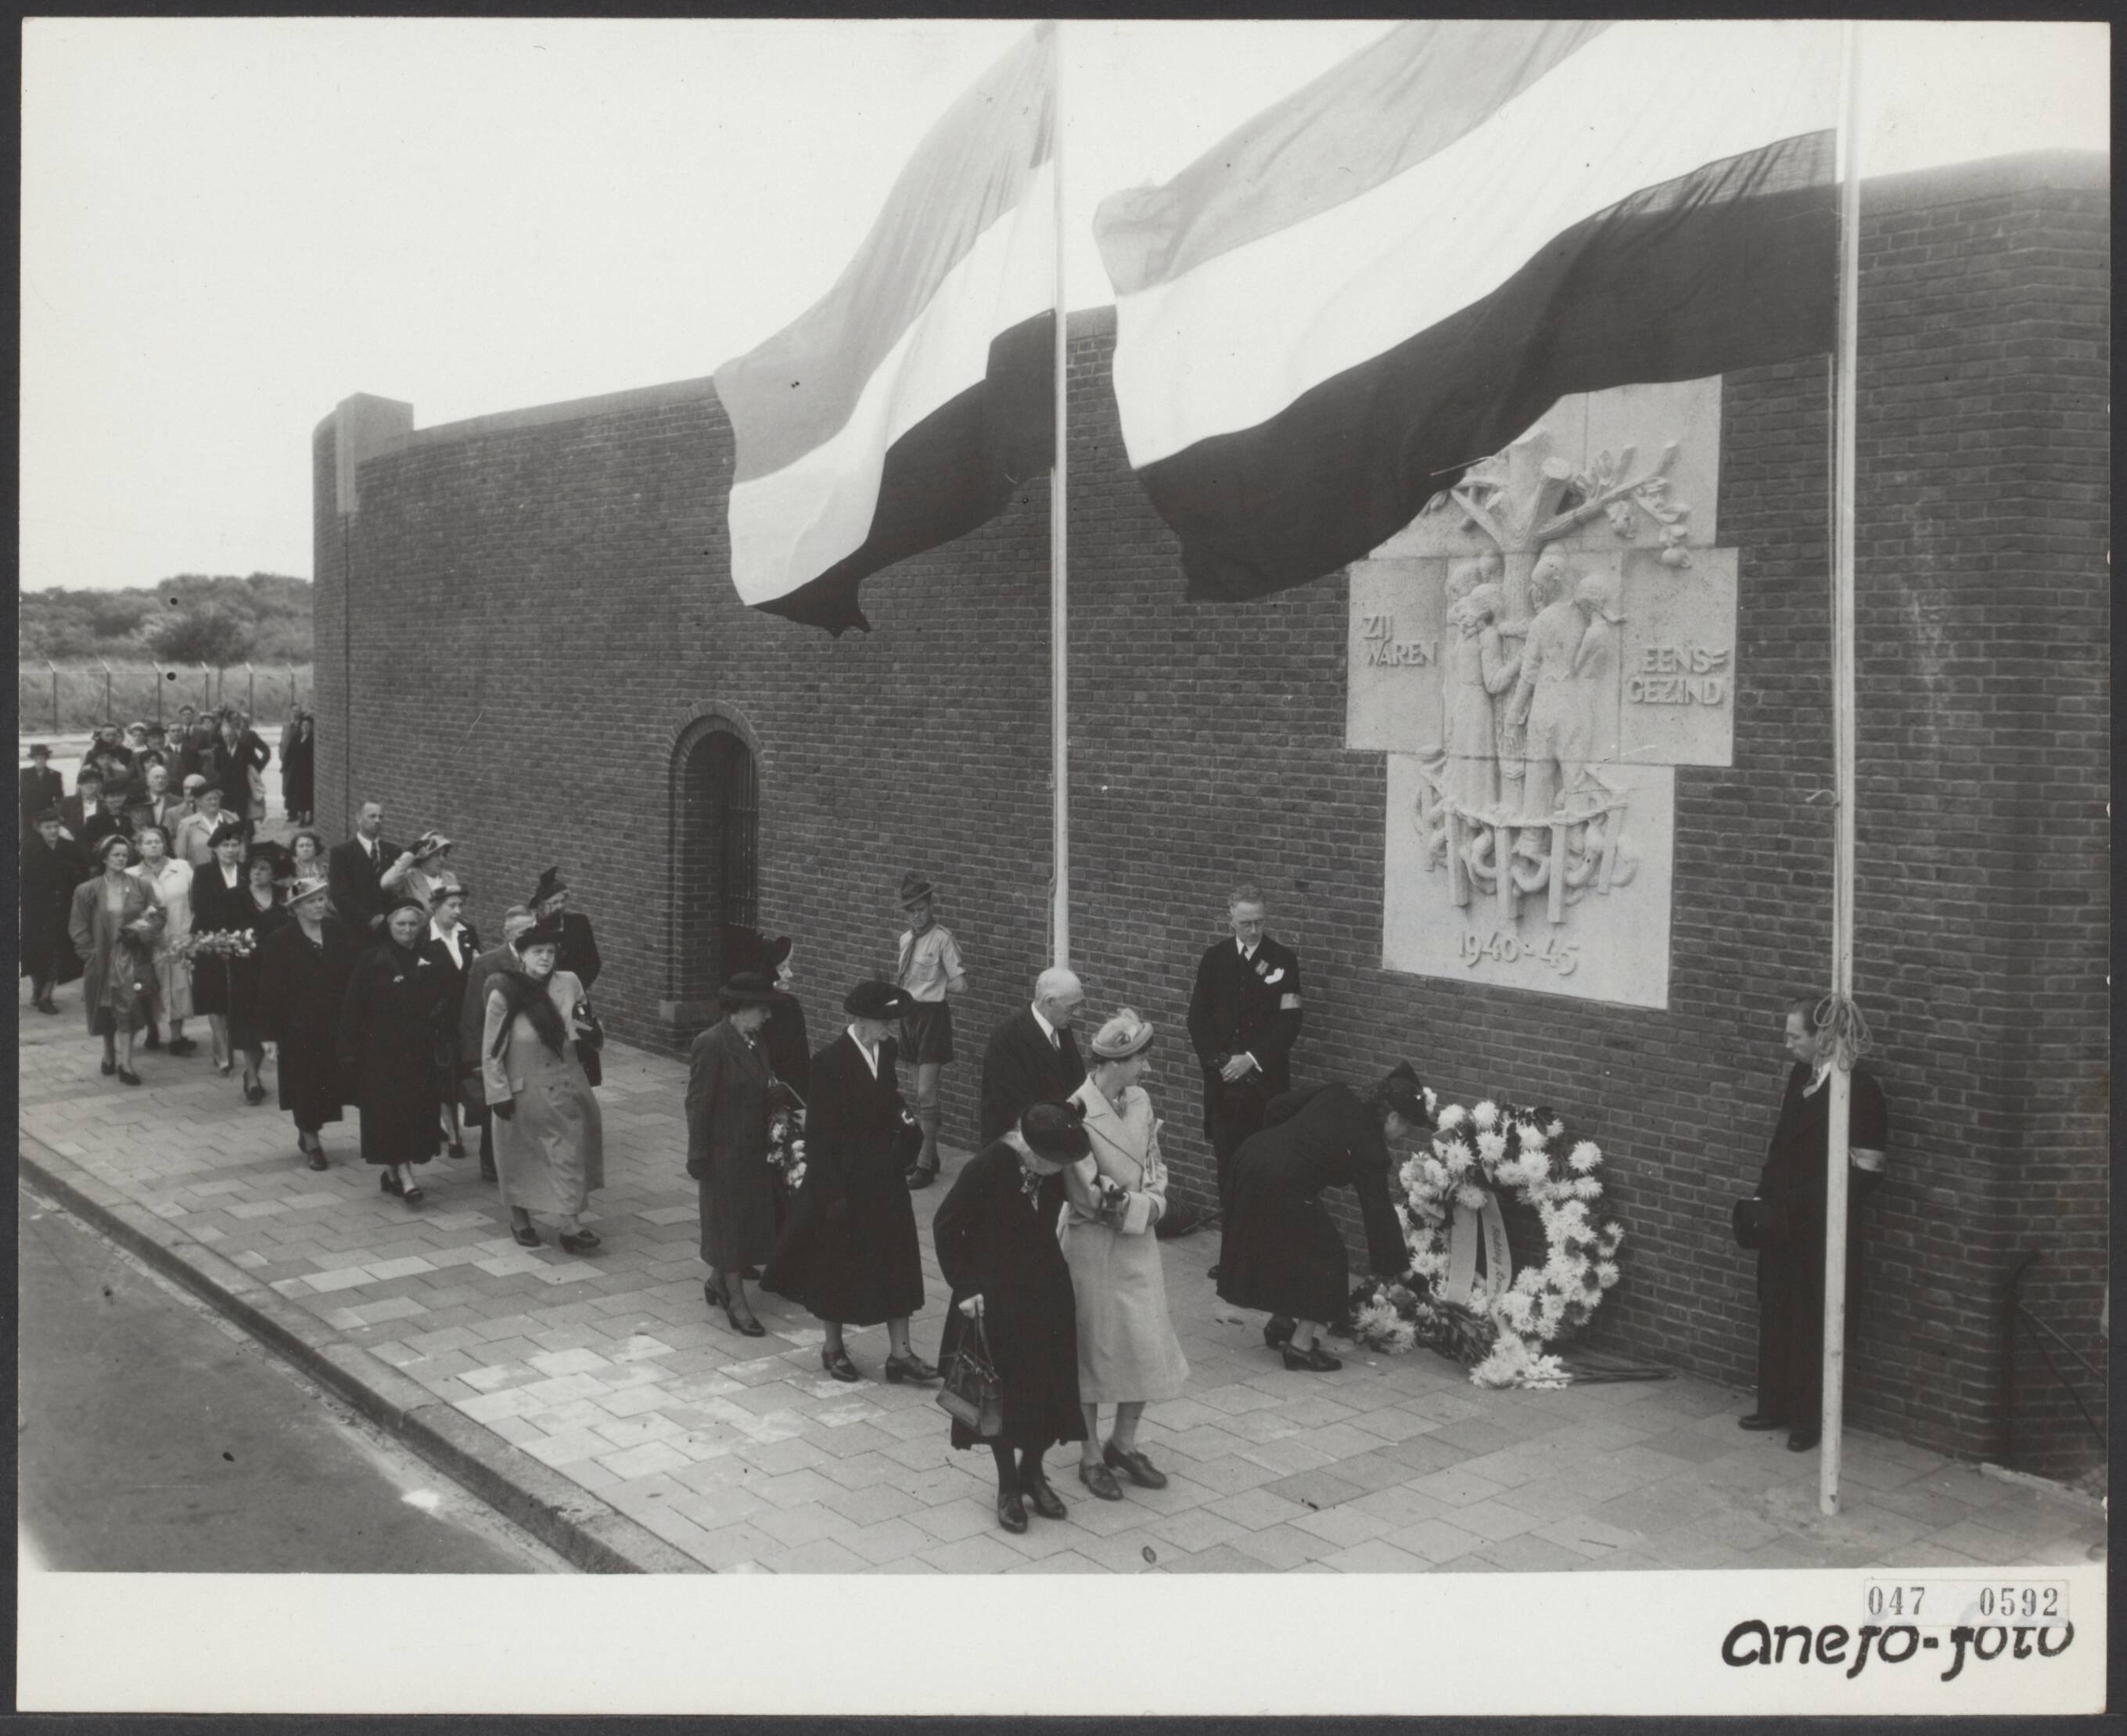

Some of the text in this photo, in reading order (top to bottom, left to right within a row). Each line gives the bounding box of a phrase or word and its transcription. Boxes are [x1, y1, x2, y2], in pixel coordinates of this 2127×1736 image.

[1362, 613, 1394, 642] ZIJ
[1365, 639, 1439, 667] WAREN
[1627, 676, 1723, 706] GEZIND
